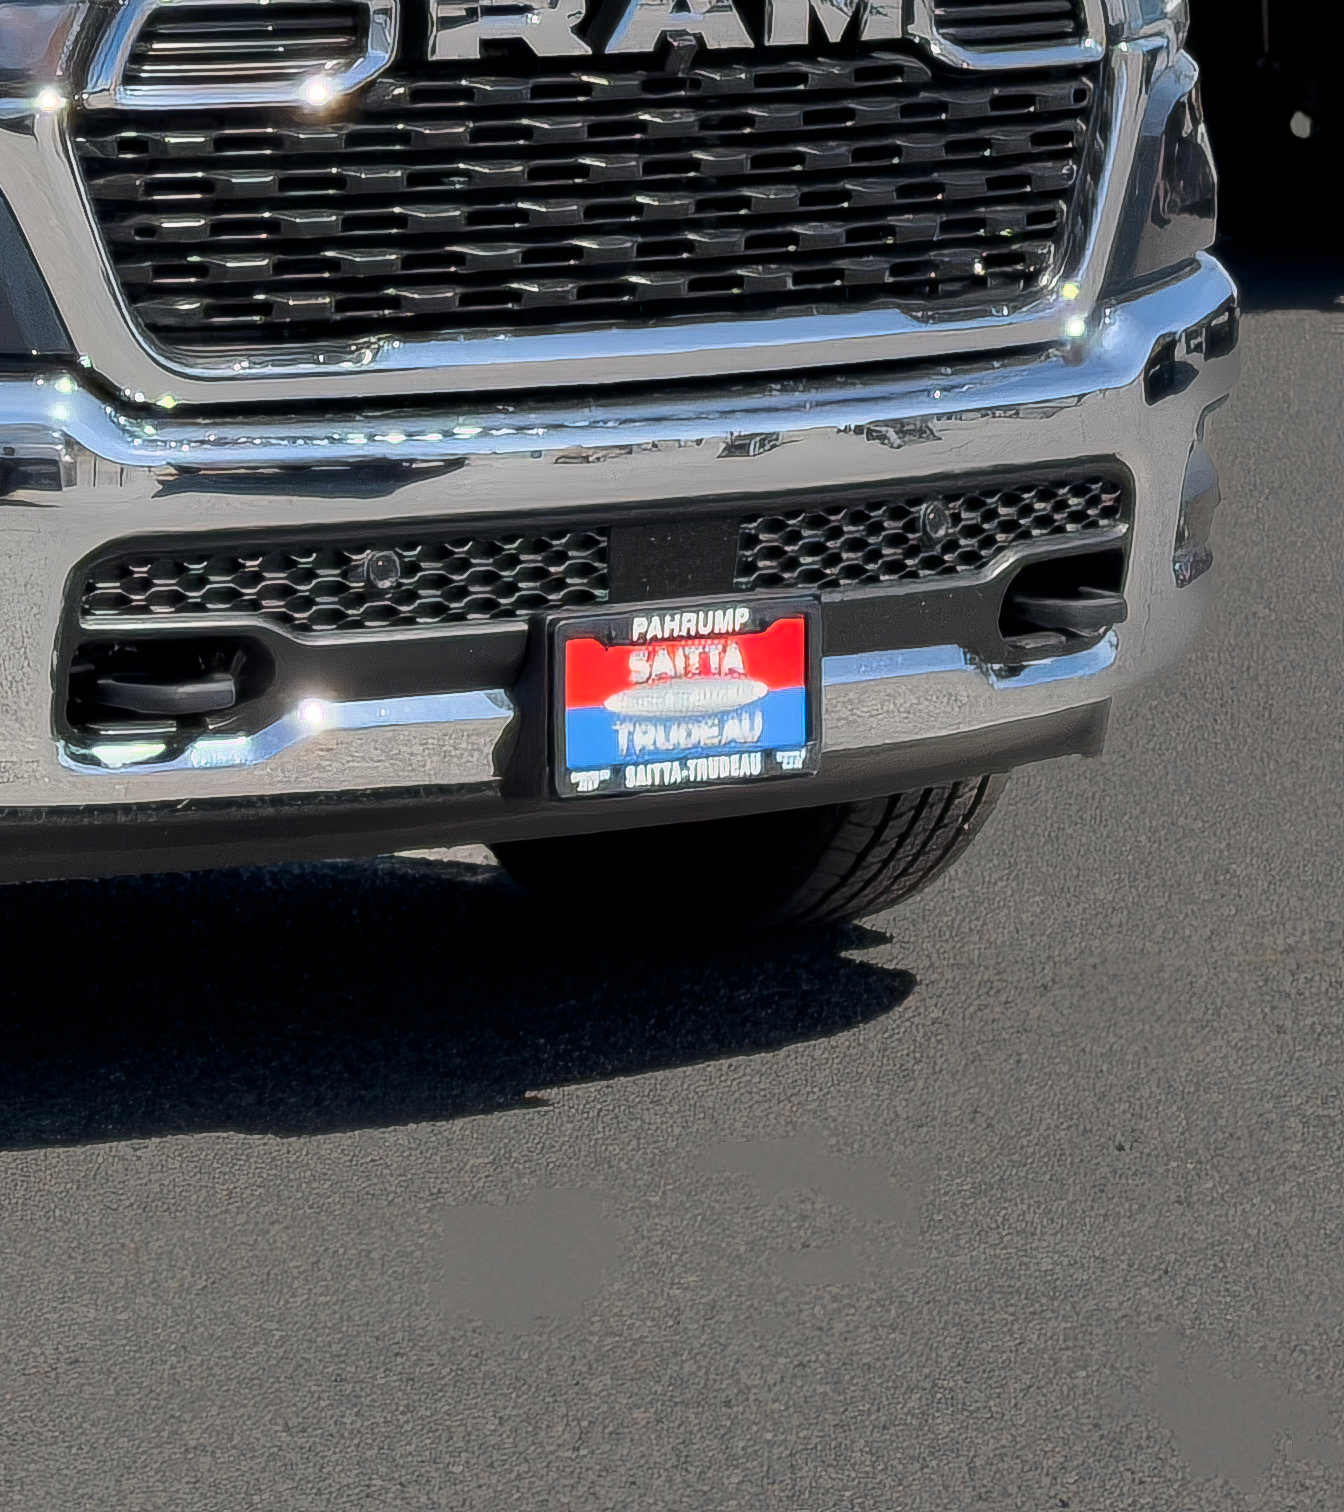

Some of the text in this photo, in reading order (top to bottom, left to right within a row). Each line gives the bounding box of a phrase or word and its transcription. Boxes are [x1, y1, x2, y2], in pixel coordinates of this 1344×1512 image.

[632, 607, 750, 641] PAHRUMP
[628, 642, 746, 684] SAITTA
[613, 710, 762, 756] TRUDEAU
[625, 752, 761, 788] SAITTA-TRUDEAU
